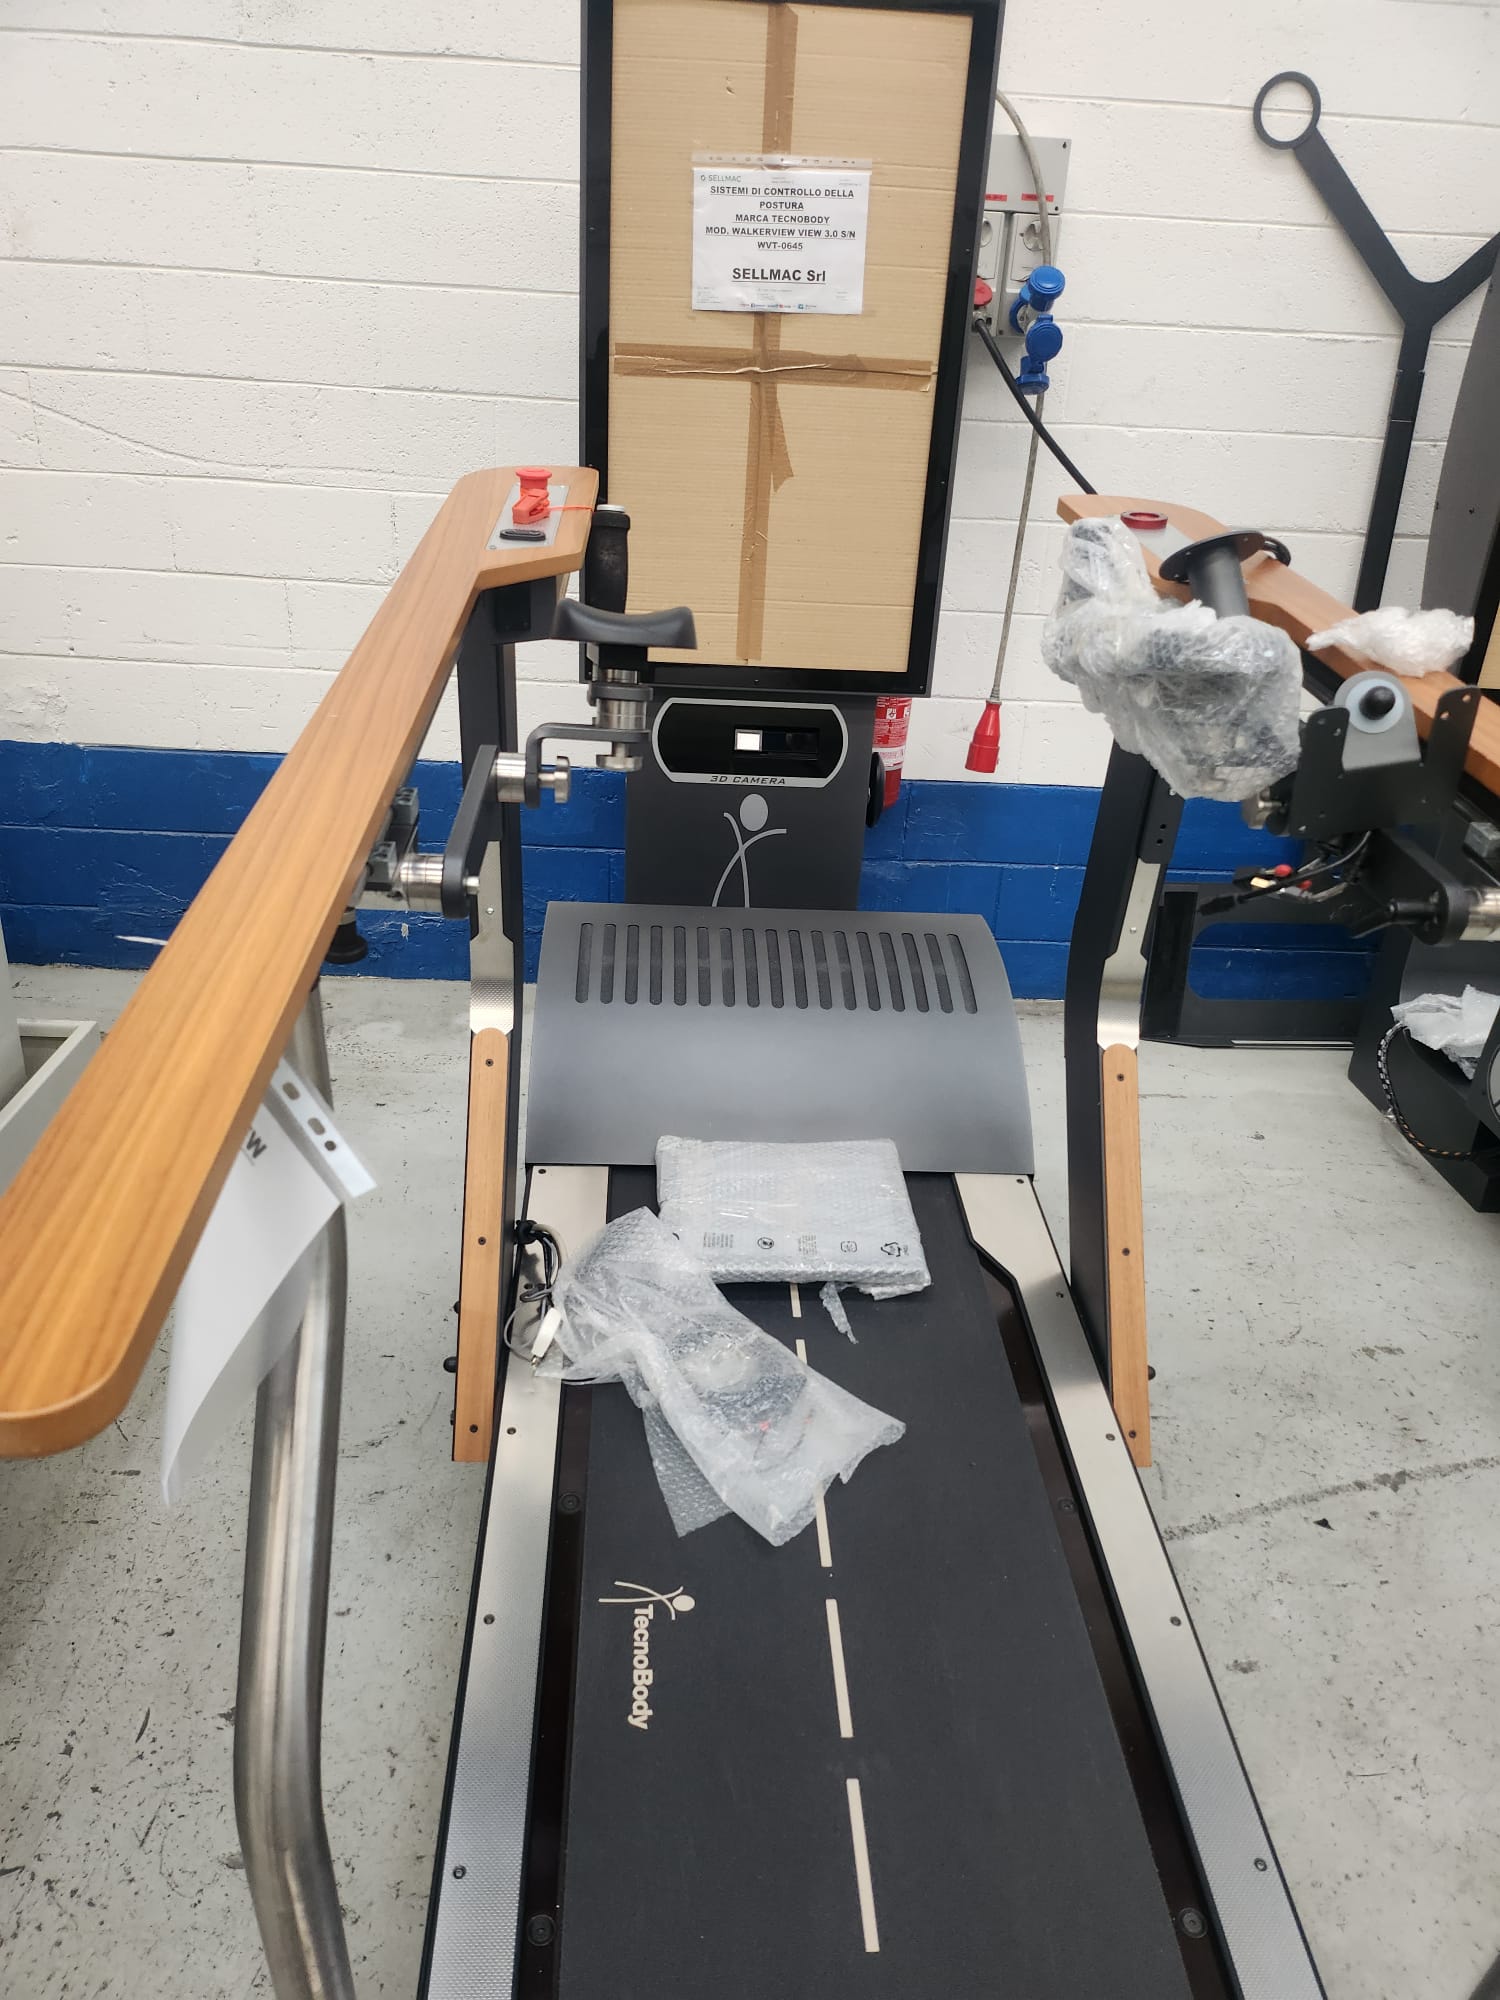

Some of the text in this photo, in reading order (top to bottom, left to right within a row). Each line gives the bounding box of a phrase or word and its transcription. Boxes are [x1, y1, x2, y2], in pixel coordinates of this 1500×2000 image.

[708, 175, 741, 183] SELLMAC
[710, 186, 748, 195] SISTEMI
[764, 188, 822, 197] CONTROLLO
[824, 189, 854, 198] DELLA
[759, 201, 804, 210] POSTURA
[735, 214, 830, 224] MARCA TECNOBODY
[705, 226, 856, 238] MOD. WALKERVIEW VIEW 3.0 S/N
[757, 241, 803, 250] WVT-0645
[732, 268, 826, 282] SELLMAC Srl
[710, 775, 785, 785] 3D CAMERA
[628, 1603, 654, 1730] TecnoBody
